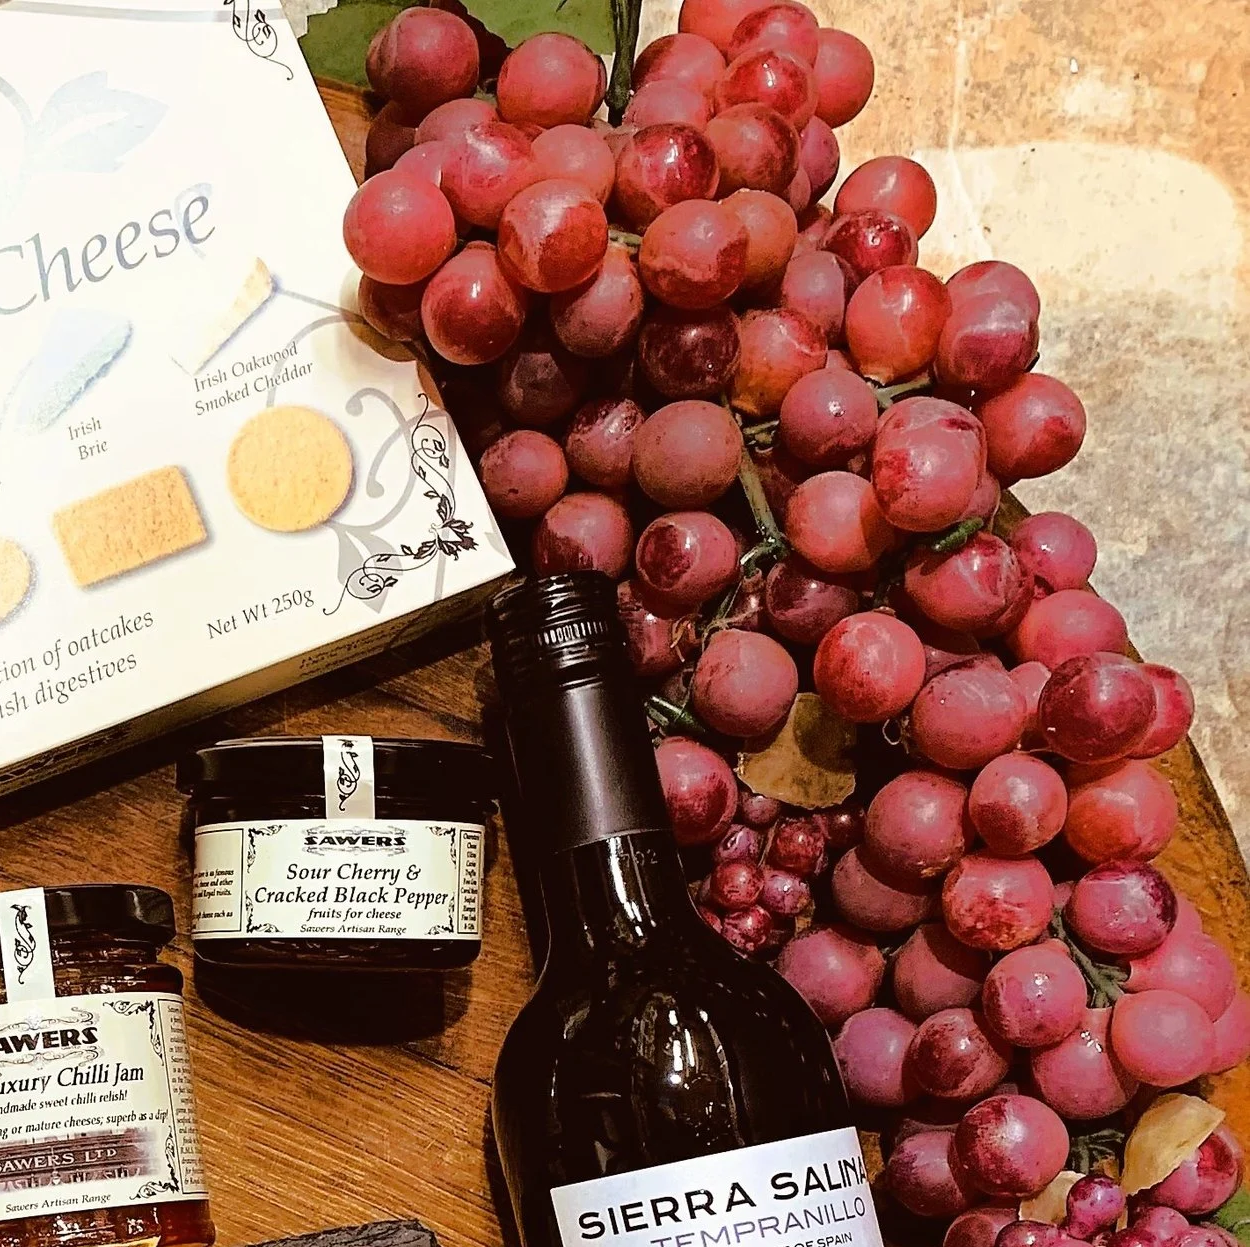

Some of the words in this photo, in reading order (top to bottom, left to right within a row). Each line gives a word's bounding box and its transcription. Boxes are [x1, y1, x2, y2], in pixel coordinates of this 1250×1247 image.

[194, 369, 228, 393] Irish
[231, 341, 299, 377] Oakwood
[195, 382, 250, 416] Smoked
[252, 360, 315, 395] Cheddar
[67, 418, 102, 441] Irish
[78, 438, 109, 460] Brie
[207, 615, 238, 641] Net
[242, 602, 268, 626] Wt
[272, 587, 315, 615] 250g
[43, 638, 63, 671] of
[67, 609, 154, 657] oatcakes
[35, 653, 138, 704] digestives
[304, 836, 407, 847] SAWERS
[287, 863, 331, 880] Sour
[337, 863, 401, 886] Cherry
[406, 864, 422, 880] &
[255, 886, 328, 903] Cracked
[334, 886, 389, 903] Black
[394, 887, 449, 910] Pepper
[307, 907, 342, 921] fruits
[343, 908, 363, 922] for
[366, 908, 402, 919] cheese
[300, 924, 335, 933] Sawers
[337, 924, 375, 933] Artisan
[378, 925, 407, 936] Range
[57, 1064, 110, 1087] Chilli
[112, 1063, 144, 1086] Jam
[38, 1096, 68, 1110] sweet
[70, 1092, 96, 1106] chilli
[99, 1090, 128, 1104] relish!
[11, 1124, 22, 1135] or
[25, 1119, 61, 1133] mature
[106, 1111, 137, 1129] superb
[139, 1112, 147, 1122] as
[85, 1149, 118, 1163] LTD
[5, 1202, 38, 1213] Sawers
[41, 1198, 78, 1208] Artisan
[82, 1194, 111, 1204] Range
[578, 1182, 756, 1240] SIERRA
